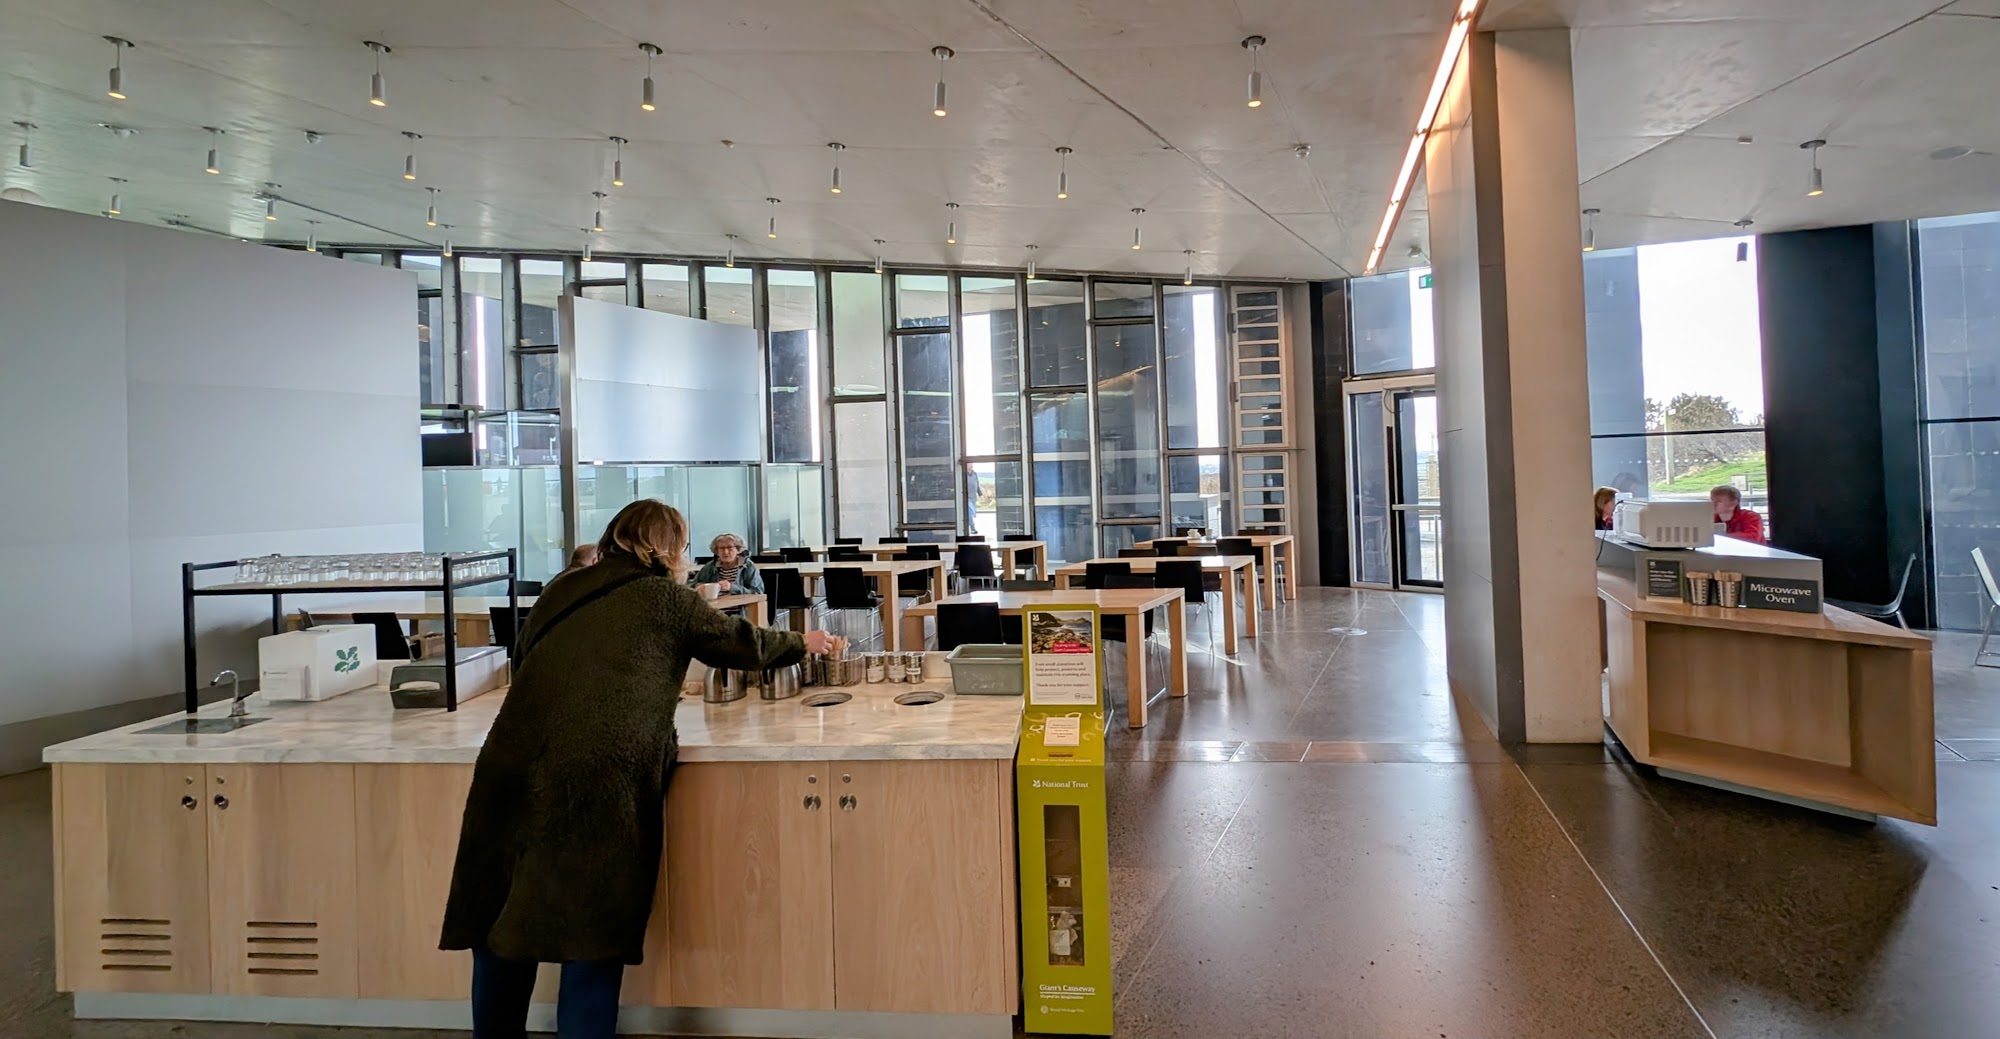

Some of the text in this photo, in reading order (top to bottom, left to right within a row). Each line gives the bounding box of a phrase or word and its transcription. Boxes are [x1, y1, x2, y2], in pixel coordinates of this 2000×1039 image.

[1750, 583, 1811, 596] Microwave
[1765, 593, 1795, 604] Oven
[1062, 984, 1096, 993] Causeway
